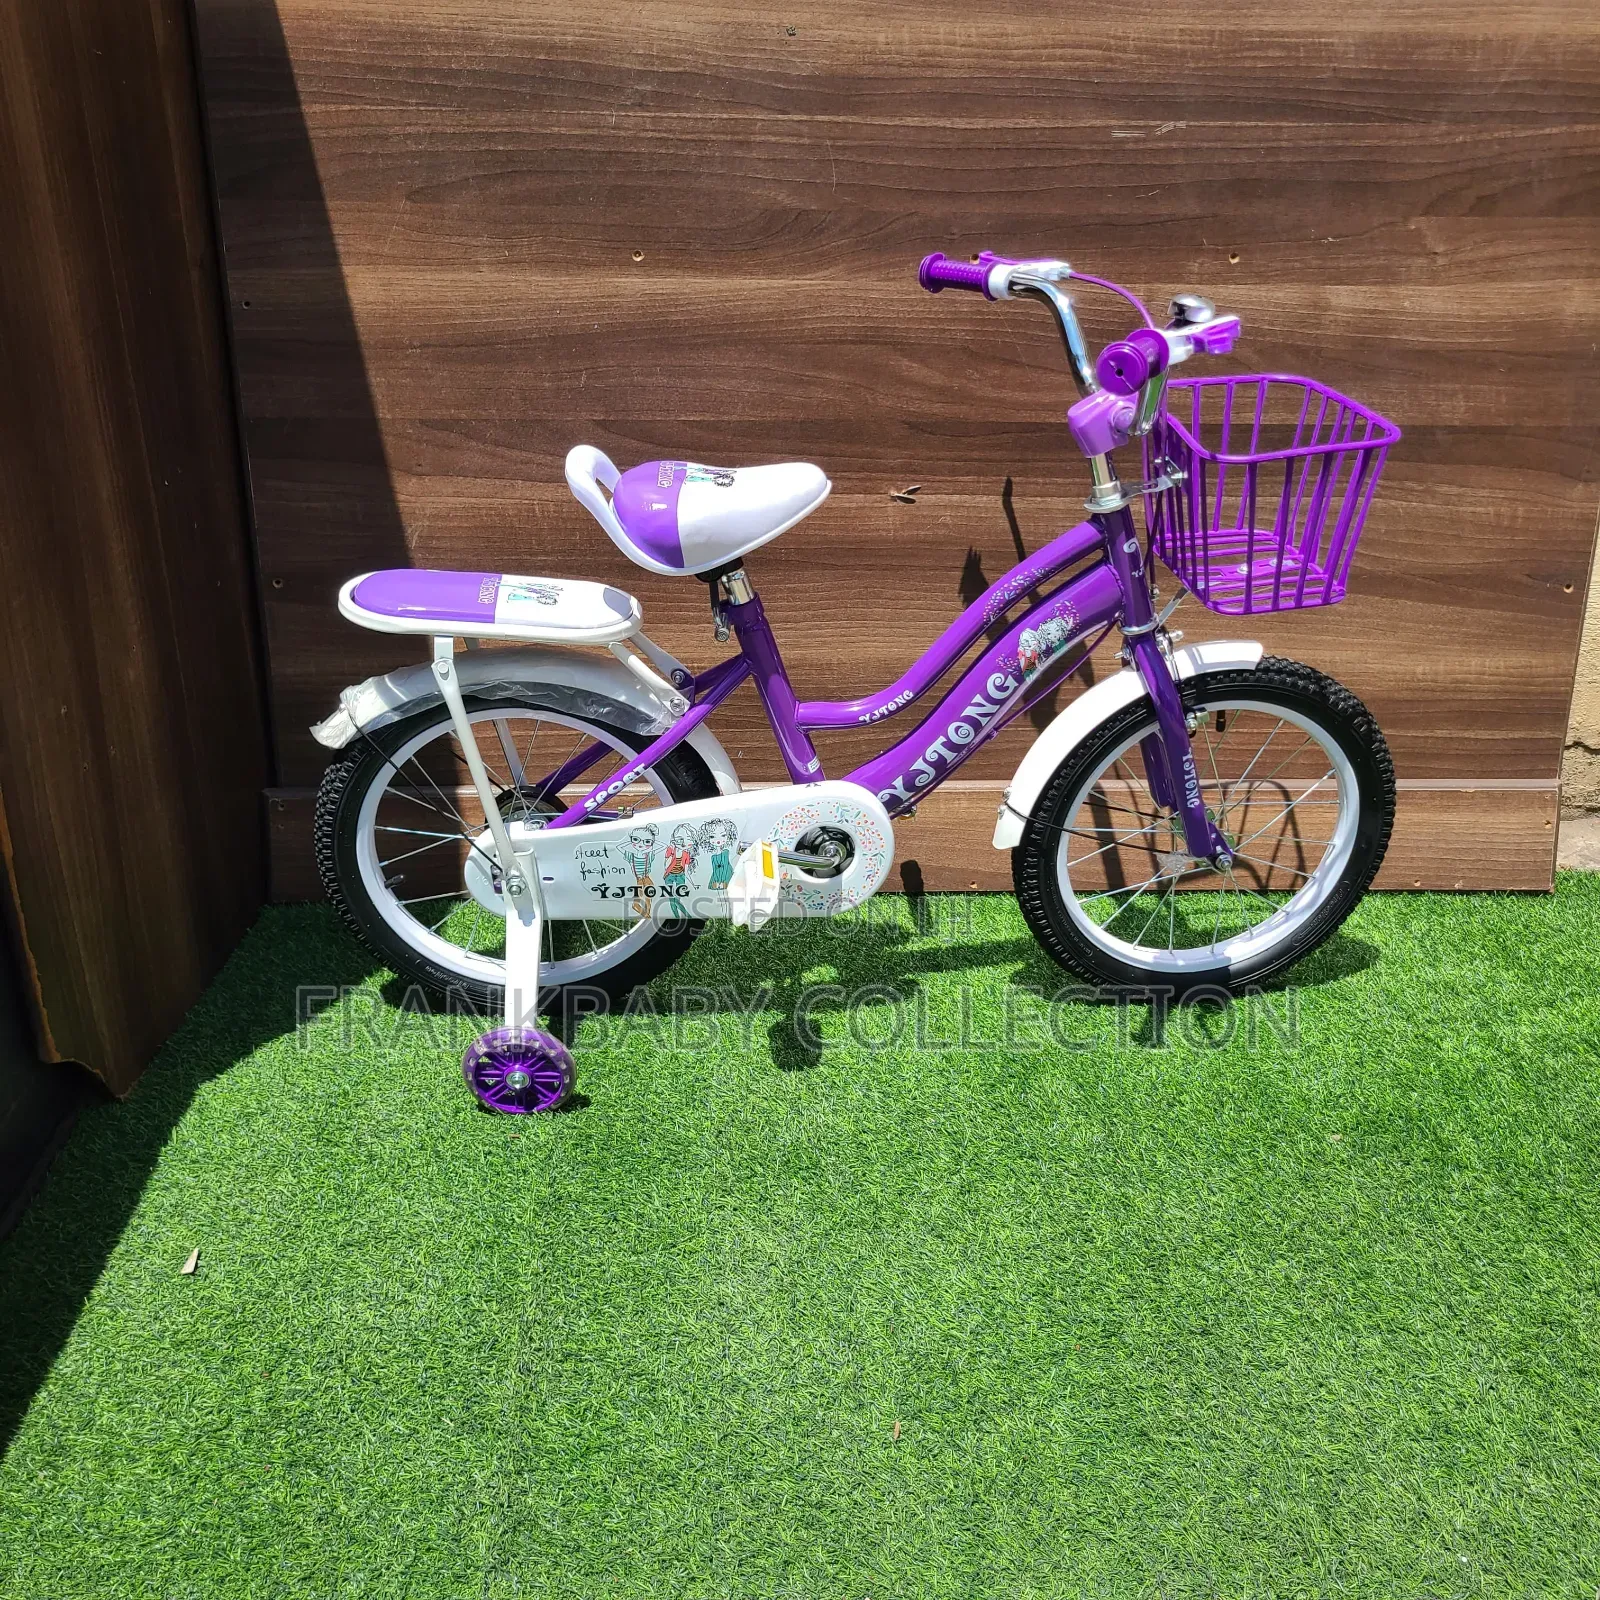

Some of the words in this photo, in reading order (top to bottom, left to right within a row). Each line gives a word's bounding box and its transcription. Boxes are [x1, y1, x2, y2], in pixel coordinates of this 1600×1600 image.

[858, 689, 914, 724] YJTONG
[876, 672, 1019, 802] YJTONG
[583, 762, 646, 812] SPORT
[1182, 746, 1200, 808] YJTONG
[590, 882, 691, 899] YJTONG
